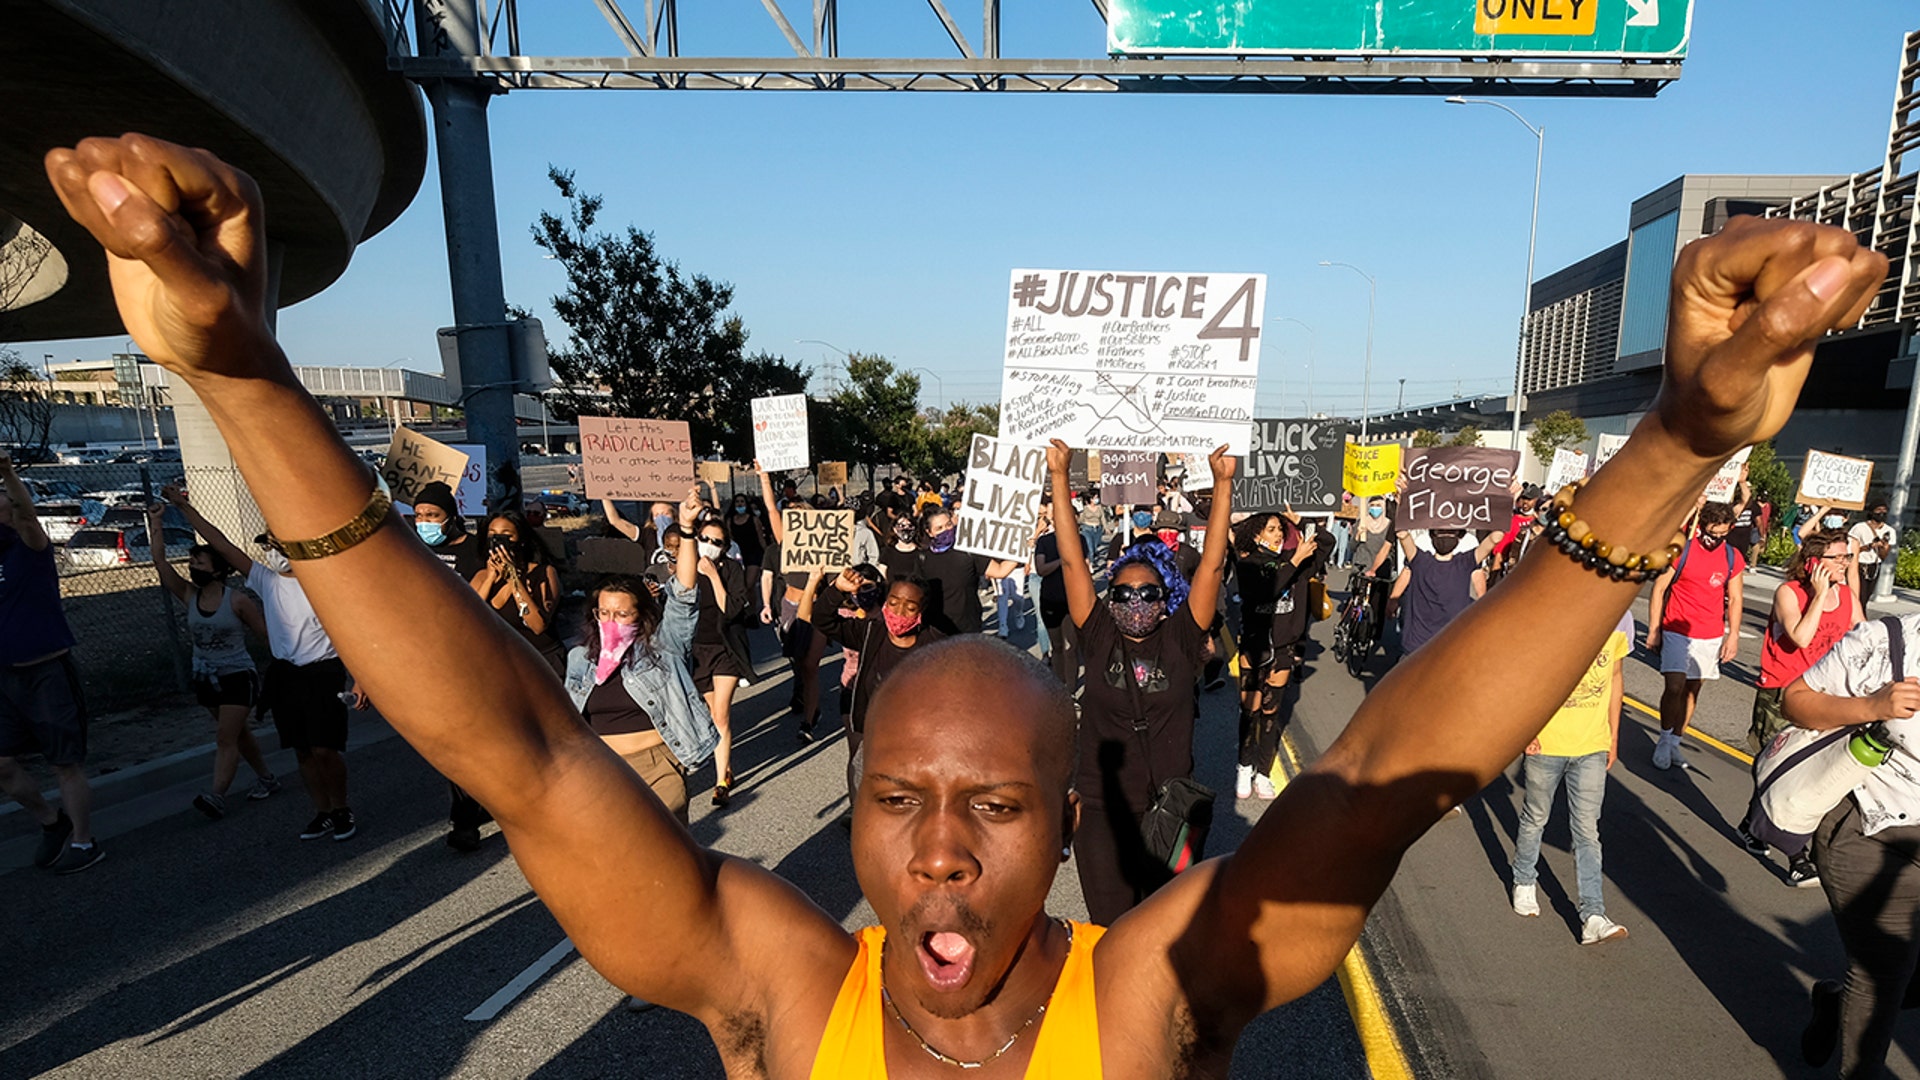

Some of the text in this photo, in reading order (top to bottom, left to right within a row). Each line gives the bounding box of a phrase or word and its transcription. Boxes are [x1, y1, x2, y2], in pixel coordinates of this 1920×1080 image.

[1482, 0, 1585, 20] ONLY
[1011, 315, 1046, 332] #ALL
[1013, 271, 1260, 362] #JUSTICE 4
[605, 420, 664, 434] Let this
[1250, 421, 1319, 453] BLACK
[402, 438, 425, 460] HE
[619, 456, 661, 466] rather
[972, 436, 1046, 485] BLACK
[1808, 453, 1869, 477] PROSECUTE
[590, 471, 615, 482] lead
[620, 475, 641, 488] you
[649, 472, 661, 481] to
[1101, 471, 1150, 489] RACISM
[1408, 455, 1511, 495] George
[1811, 468, 1861, 485] KILLER
[967, 478, 1041, 525] LIVES
[1816, 484, 1854, 498] COPS
[1408, 489, 1492, 528] Floyd
[787, 511, 849, 536] BLACK
[793, 531, 849, 554] LIVES
[957, 516, 1034, 557] MATTER
[786, 549, 853, 566] MATTER
